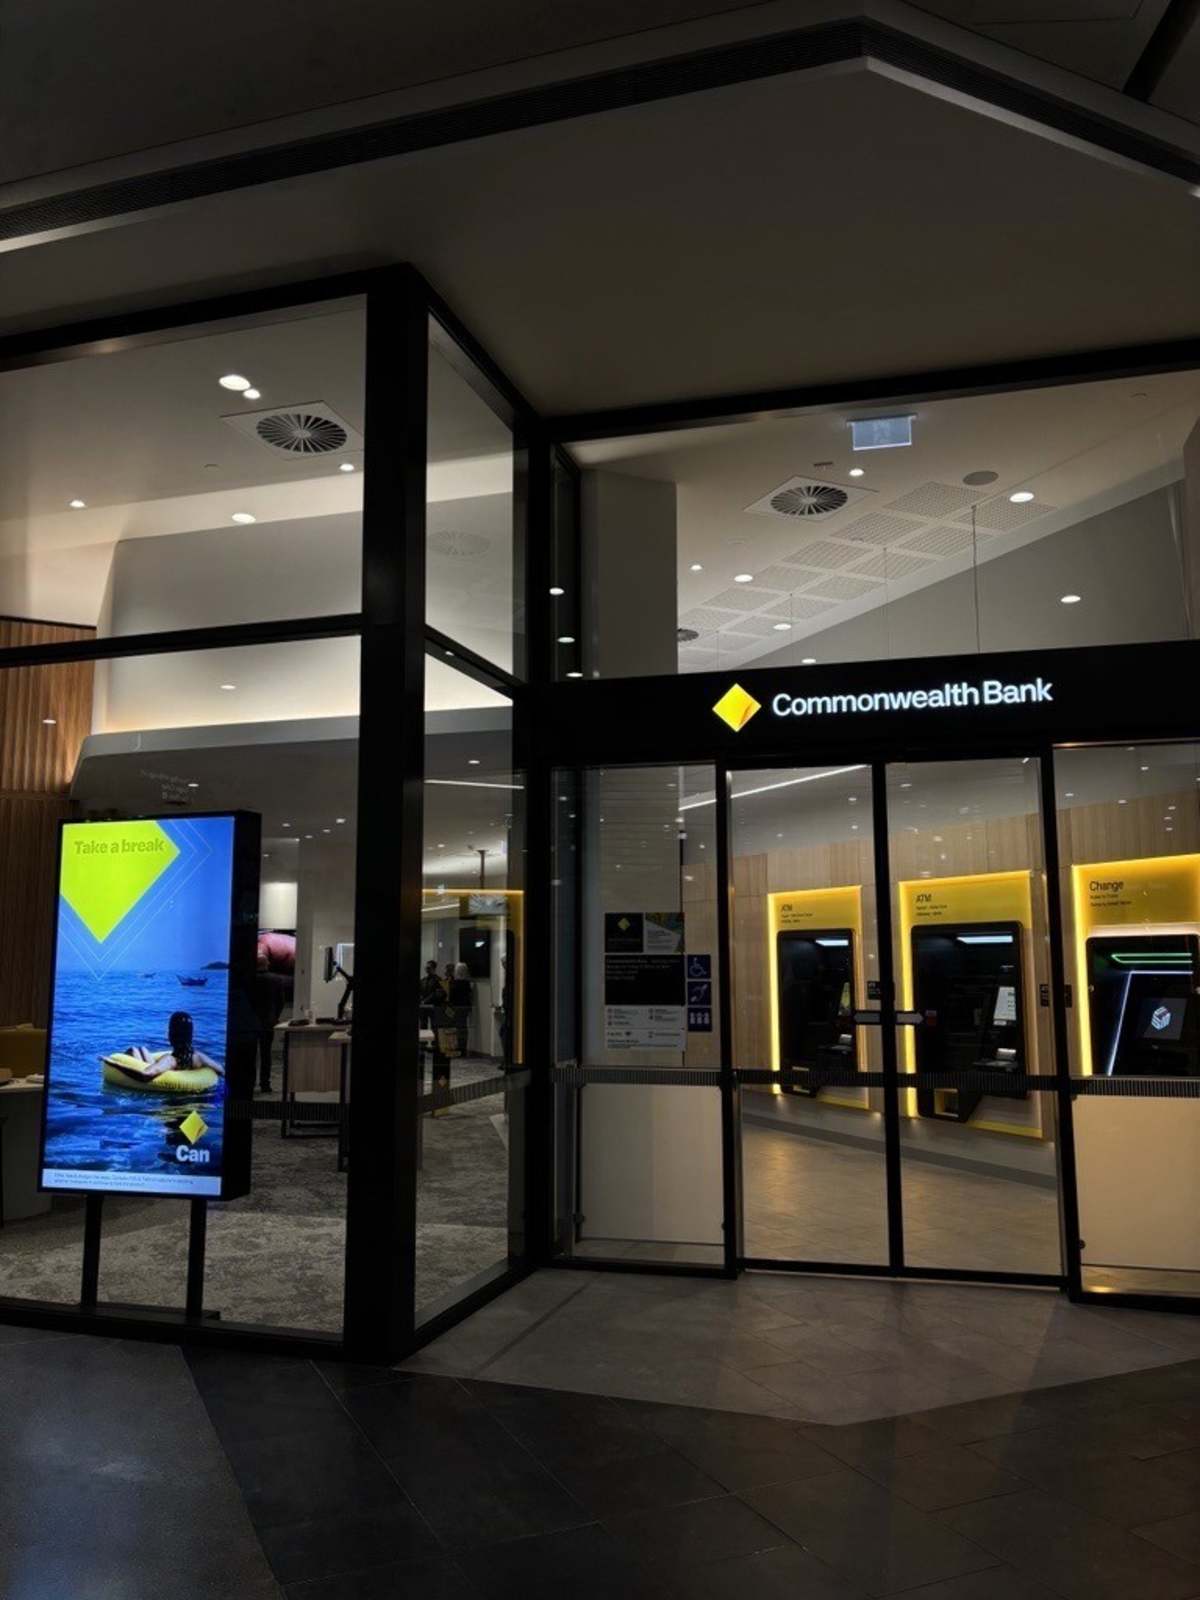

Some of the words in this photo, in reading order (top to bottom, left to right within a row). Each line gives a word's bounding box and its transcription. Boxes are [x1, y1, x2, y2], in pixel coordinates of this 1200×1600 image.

[772, 682, 979, 717] Commonwealth
[983, 677, 1054, 705] Bank
[74, 839, 107, 855] Take
[110, 842, 119, 854] a
[121, 837, 164, 854] break
[1090, 881, 1124, 893] Change
[175, 1144, 211, 1163] Can
